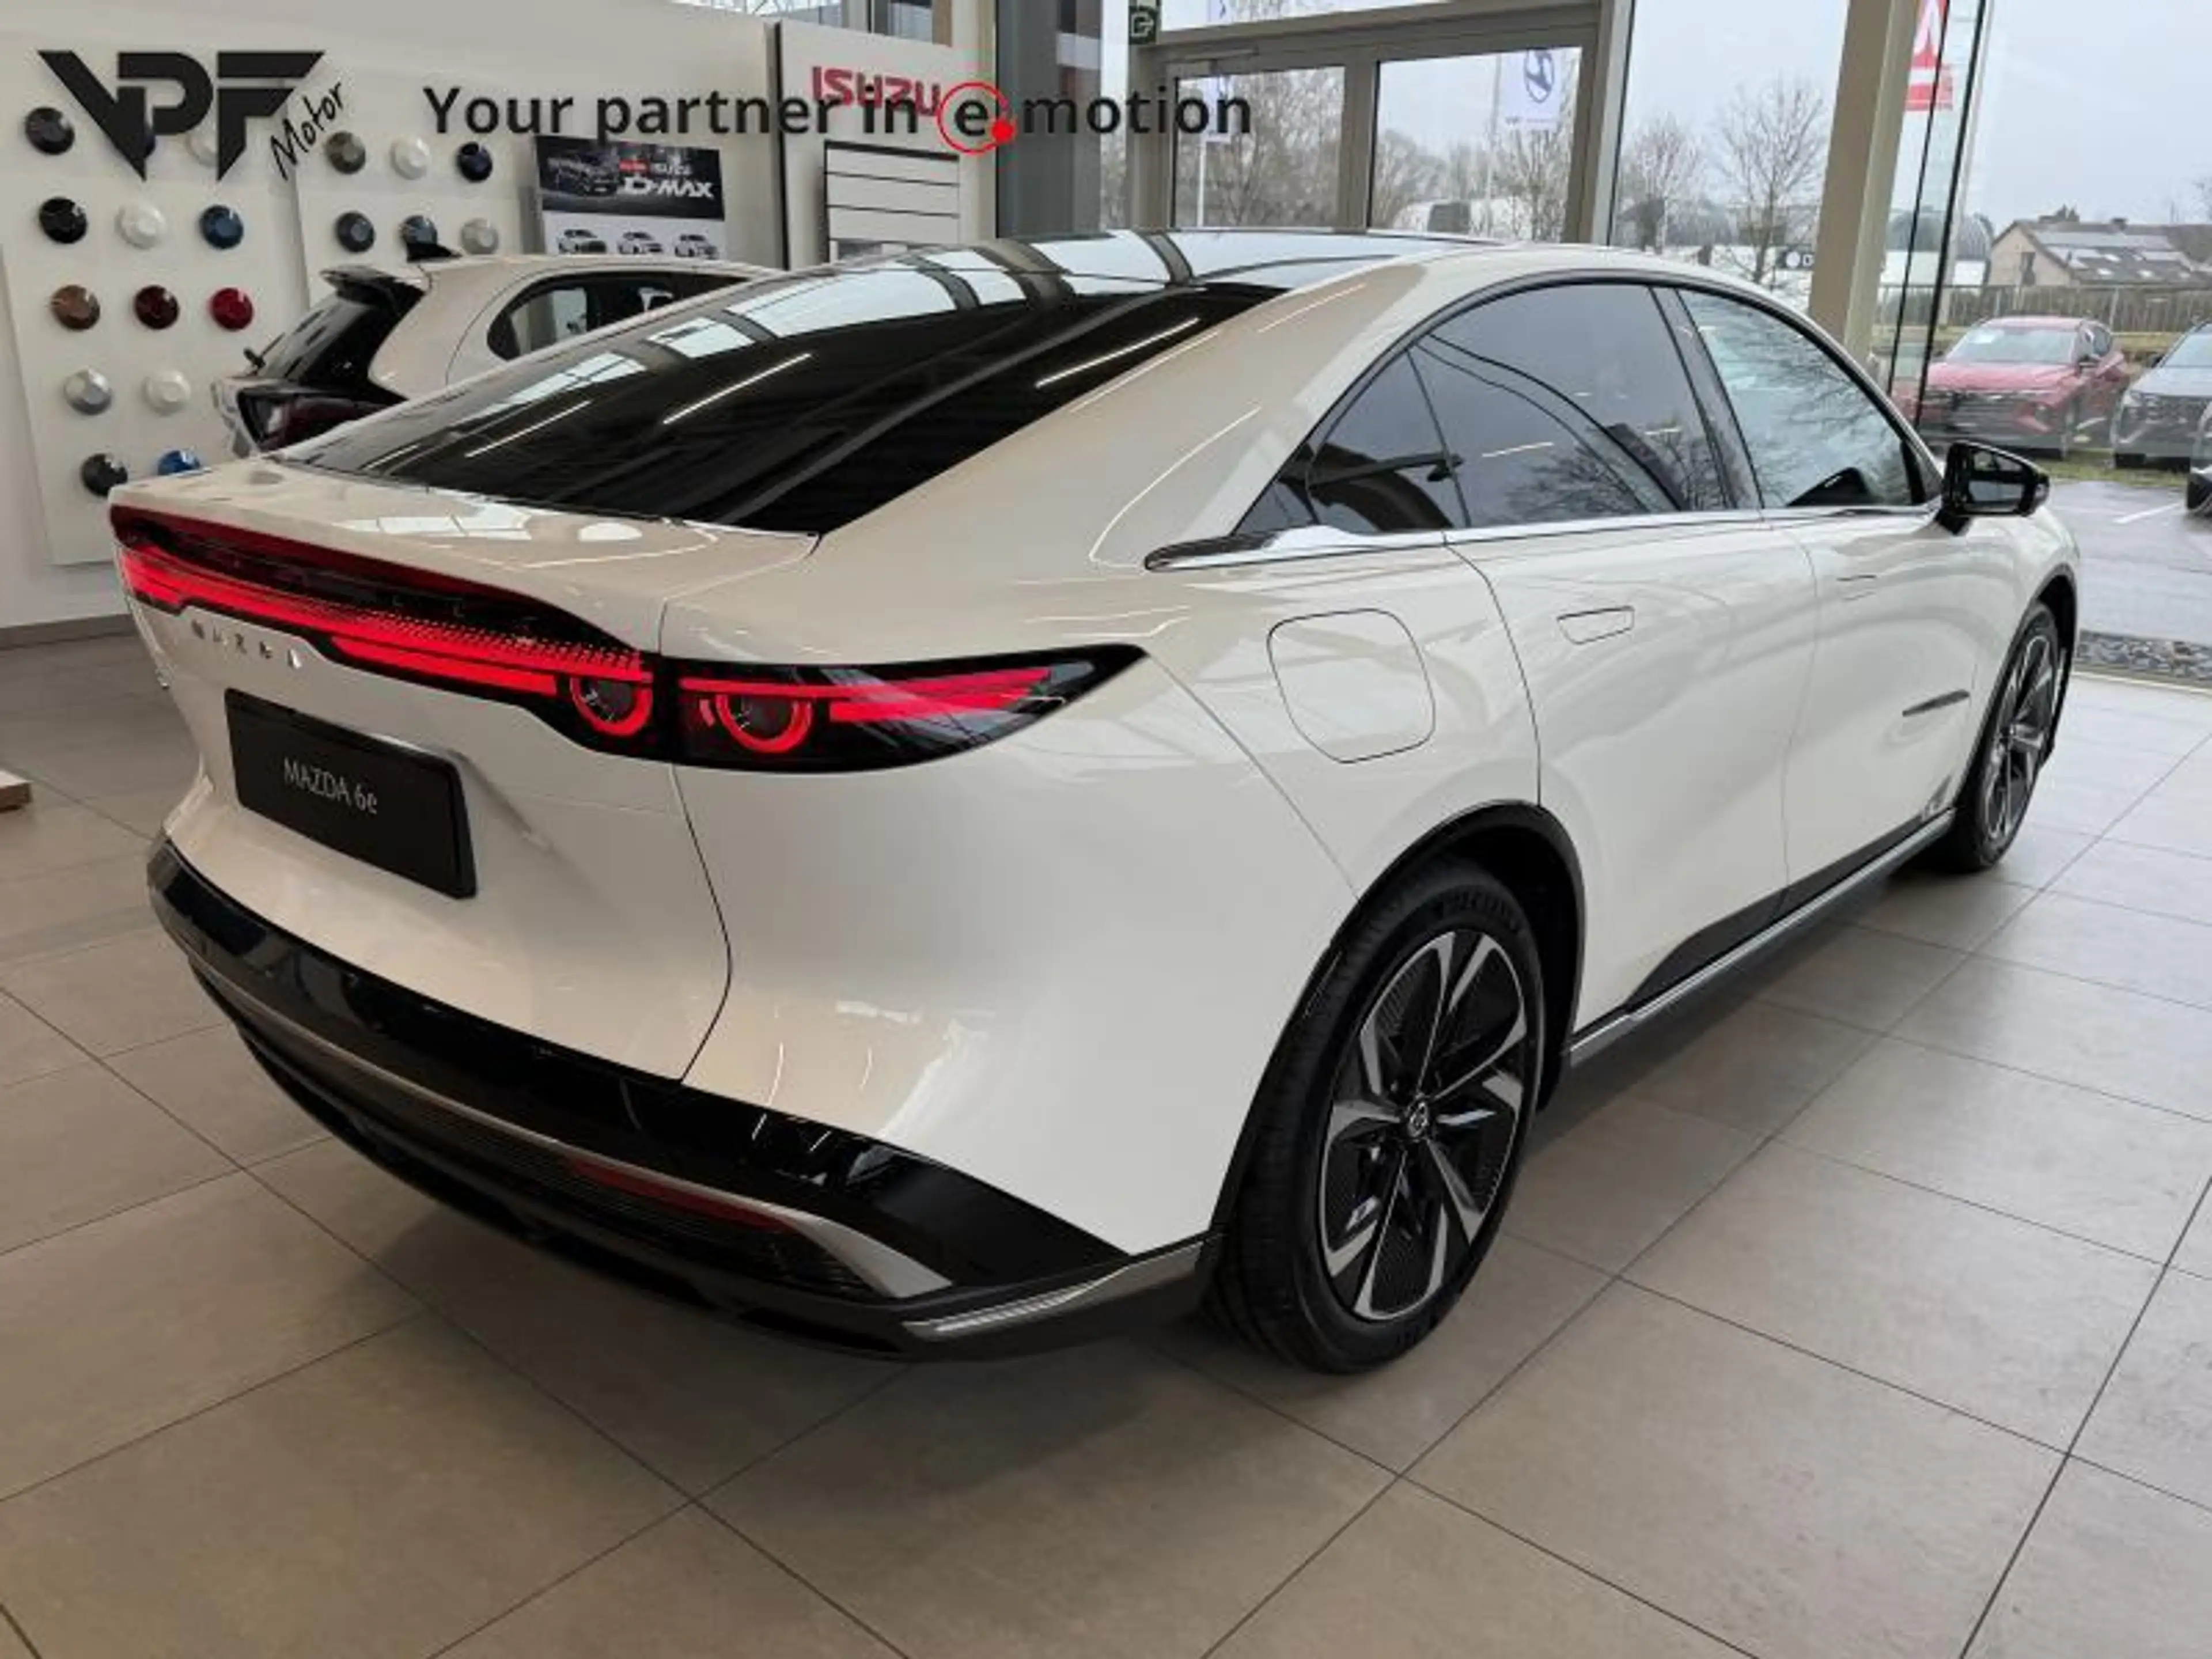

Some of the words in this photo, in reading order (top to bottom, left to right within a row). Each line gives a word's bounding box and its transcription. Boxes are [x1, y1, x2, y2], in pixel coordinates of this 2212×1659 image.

[812, 66, 941, 116] ISUZU
[623, 175, 714, 198] D-MAX
[284, 756, 352, 806] MAZDA
[354, 783, 377, 815] 6e
